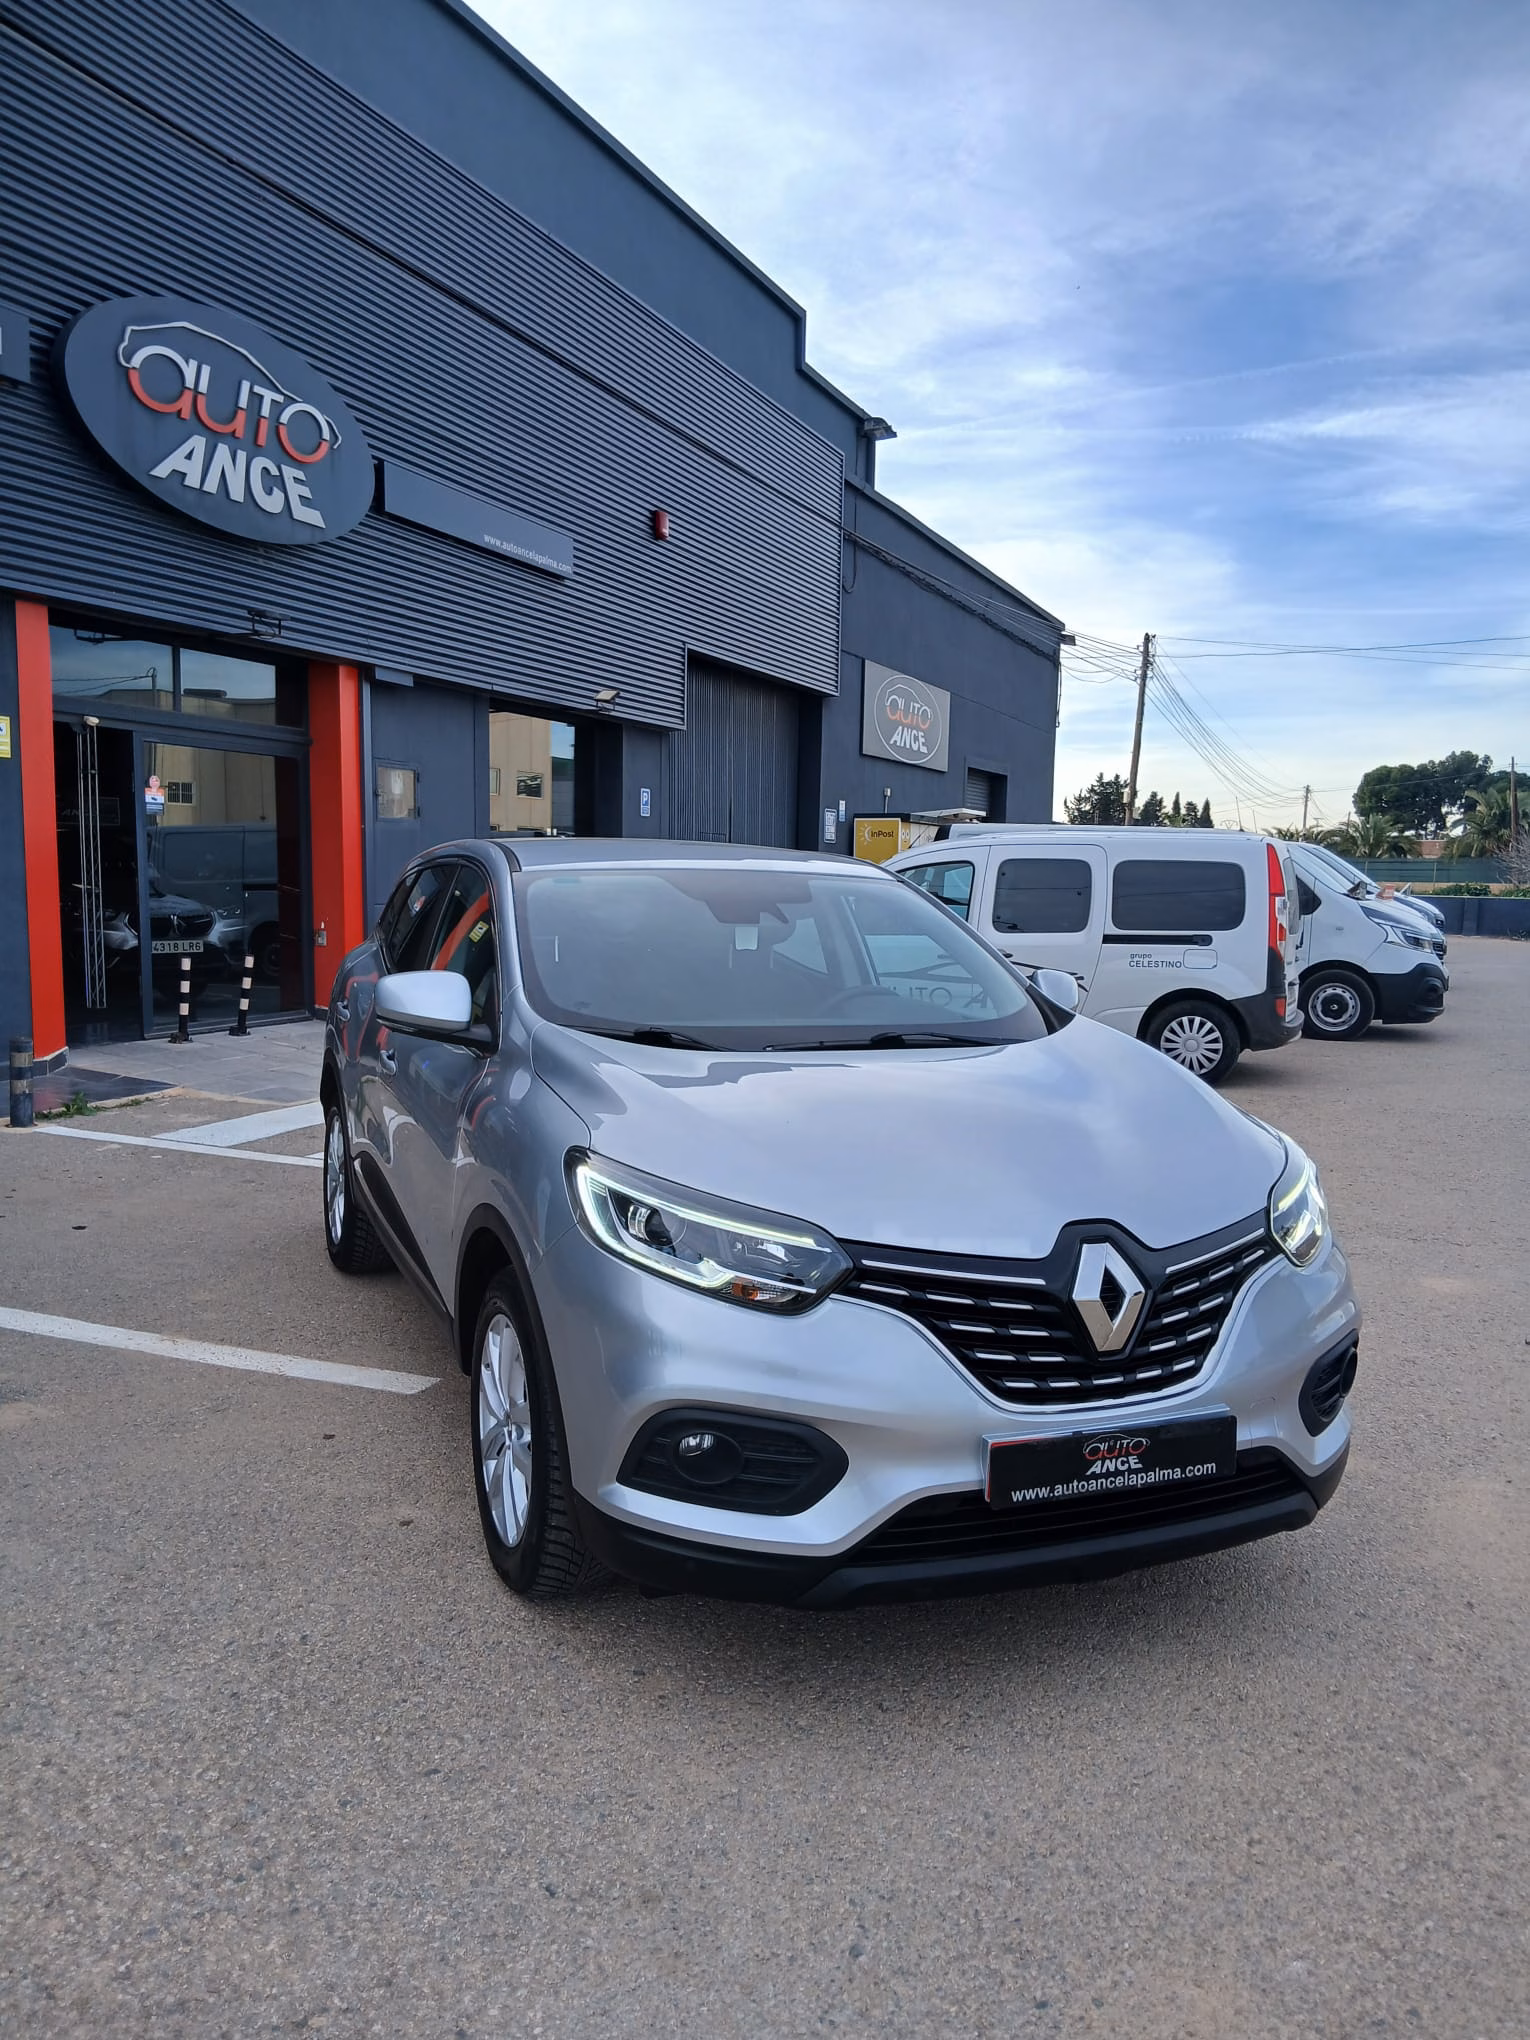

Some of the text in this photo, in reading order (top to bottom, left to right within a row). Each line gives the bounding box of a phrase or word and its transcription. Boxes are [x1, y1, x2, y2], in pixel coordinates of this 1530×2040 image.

[149, 434, 326, 529] ANCE
[483, 534, 572, 574] www.autoancelapalma.com
[889, 725, 929, 754] ANCE
[1128, 960, 1183, 969] CELESTINO
[1011, 1462, 1217, 1503] www.autoancelapalma.com
[1085, 1455, 1143, 1476] ANCE
